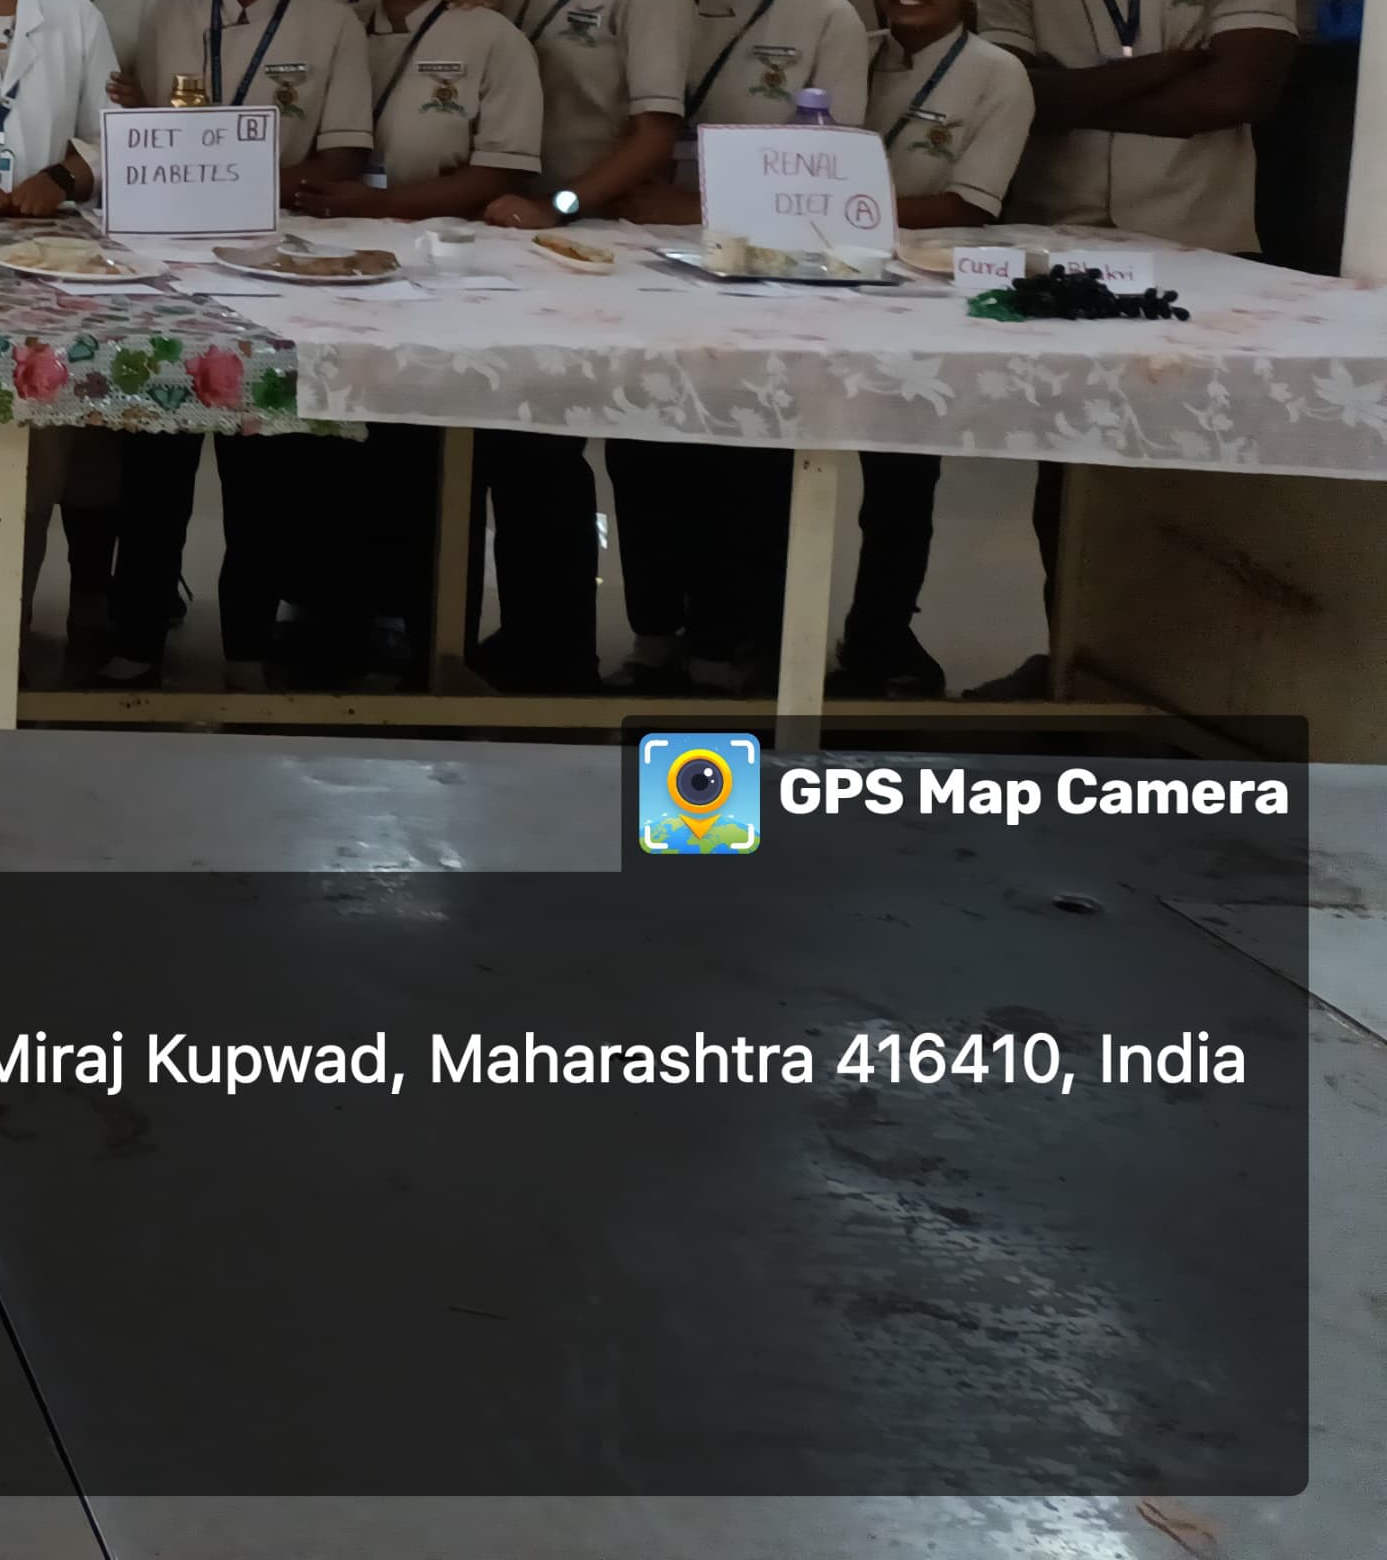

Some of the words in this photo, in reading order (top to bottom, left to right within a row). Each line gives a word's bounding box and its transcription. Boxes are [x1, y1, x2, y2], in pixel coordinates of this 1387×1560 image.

[128, 128, 183, 149] DIET
[202, 128, 228, 147] OF
[126, 163, 240, 185] DIABETES
[760, 148, 849, 181] RENAL
